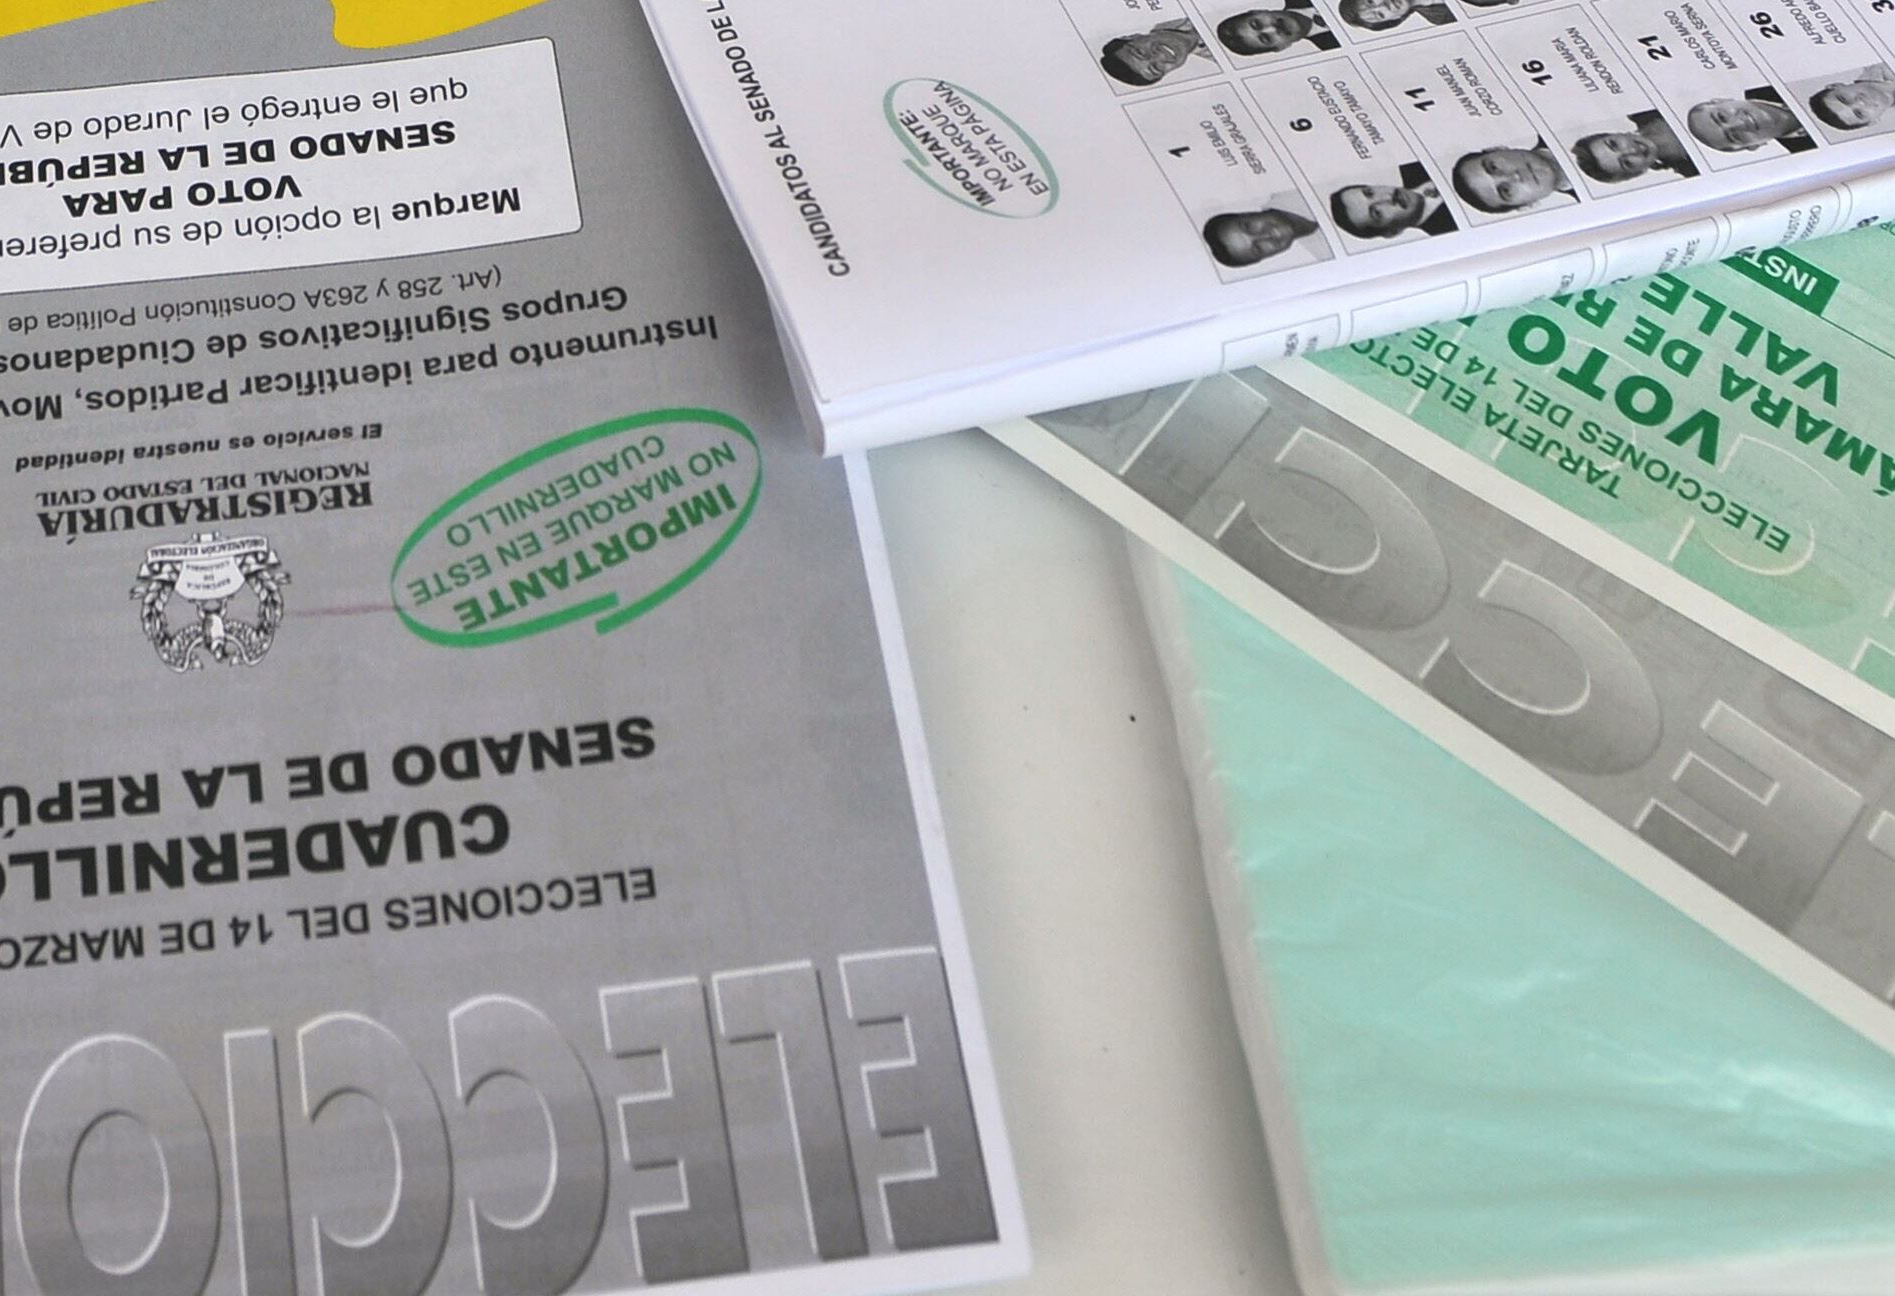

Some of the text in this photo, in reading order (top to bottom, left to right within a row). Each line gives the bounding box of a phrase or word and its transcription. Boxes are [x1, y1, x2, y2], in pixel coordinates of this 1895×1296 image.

[709, 14, 739, 43] DE
[723, 44, 776, 123] SENADO
[156, 143, 210, 172] LA
[221, 137, 276, 166] DE
[288, 119, 456, 160] SENADO
[763, 123, 790, 149] AL
[898, 108, 996, 207] IMPORTANTE:
[920, 102, 1014, 192] NO MARQUE
[932, 79, 1049, 196] EN ESTA PÁGINA
[1167, 145, 1191, 158] 1
[1198, 119, 1239, 167] LUIS EMILIO
[1210, 102, 1267, 175] SIERRA GRAJALES
[60, 174, 302, 218] VOTO PARA
[774, 152, 850, 277] CANDIDATOS
[302, 283, 369, 310] 263A
[375, 276, 390, 298] y
[396, 275, 443, 300] 258
[450, 263, 502, 292] (Art.
[6, 314, 39, 336] de
[45, 305, 136, 332] Política
[143, 291, 296, 324] Constitución
[257, 303, 491, 350] Significativos
[500, 284, 628, 322] Grupos
[205, 332, 247, 359] de
[422, 342, 498, 377] para
[508, 314, 718, 367] Instrumento
[1622, 313, 1704, 378] DE
[1639, 266, 1839, 408] VALLE
[73, 377, 229, 413] Partidos,
[238, 359, 413, 397] identificar
[1506, 312, 1721, 466] VOTO
[14, 421, 383, 473] El servicio es nuestra identidad
[1409, 325, 1791, 554] ELECCIONES DEL 14 DE
[1483, 401, 1621, 500] TARJETA
[34, 460, 370, 508] NACIONAL DEL ESTADO CIVIL
[445, 434, 666, 548] CUADERNILLO
[35, 479, 373, 537] REGISTRADURÍA
[405, 439, 737, 606] NO MARQUE EN ESTE
[452, 481, 738, 633] IMPORTANTE
[390, 715, 656, 787] SENADO
[180, 760, 264, 810] LA
[284, 750, 369, 800] DE
[285, 901, 370, 940] DEL
[382, 866, 657, 931] ELECCIONES
[158, 917, 216, 956] DE
[227, 912, 274, 948] 14
